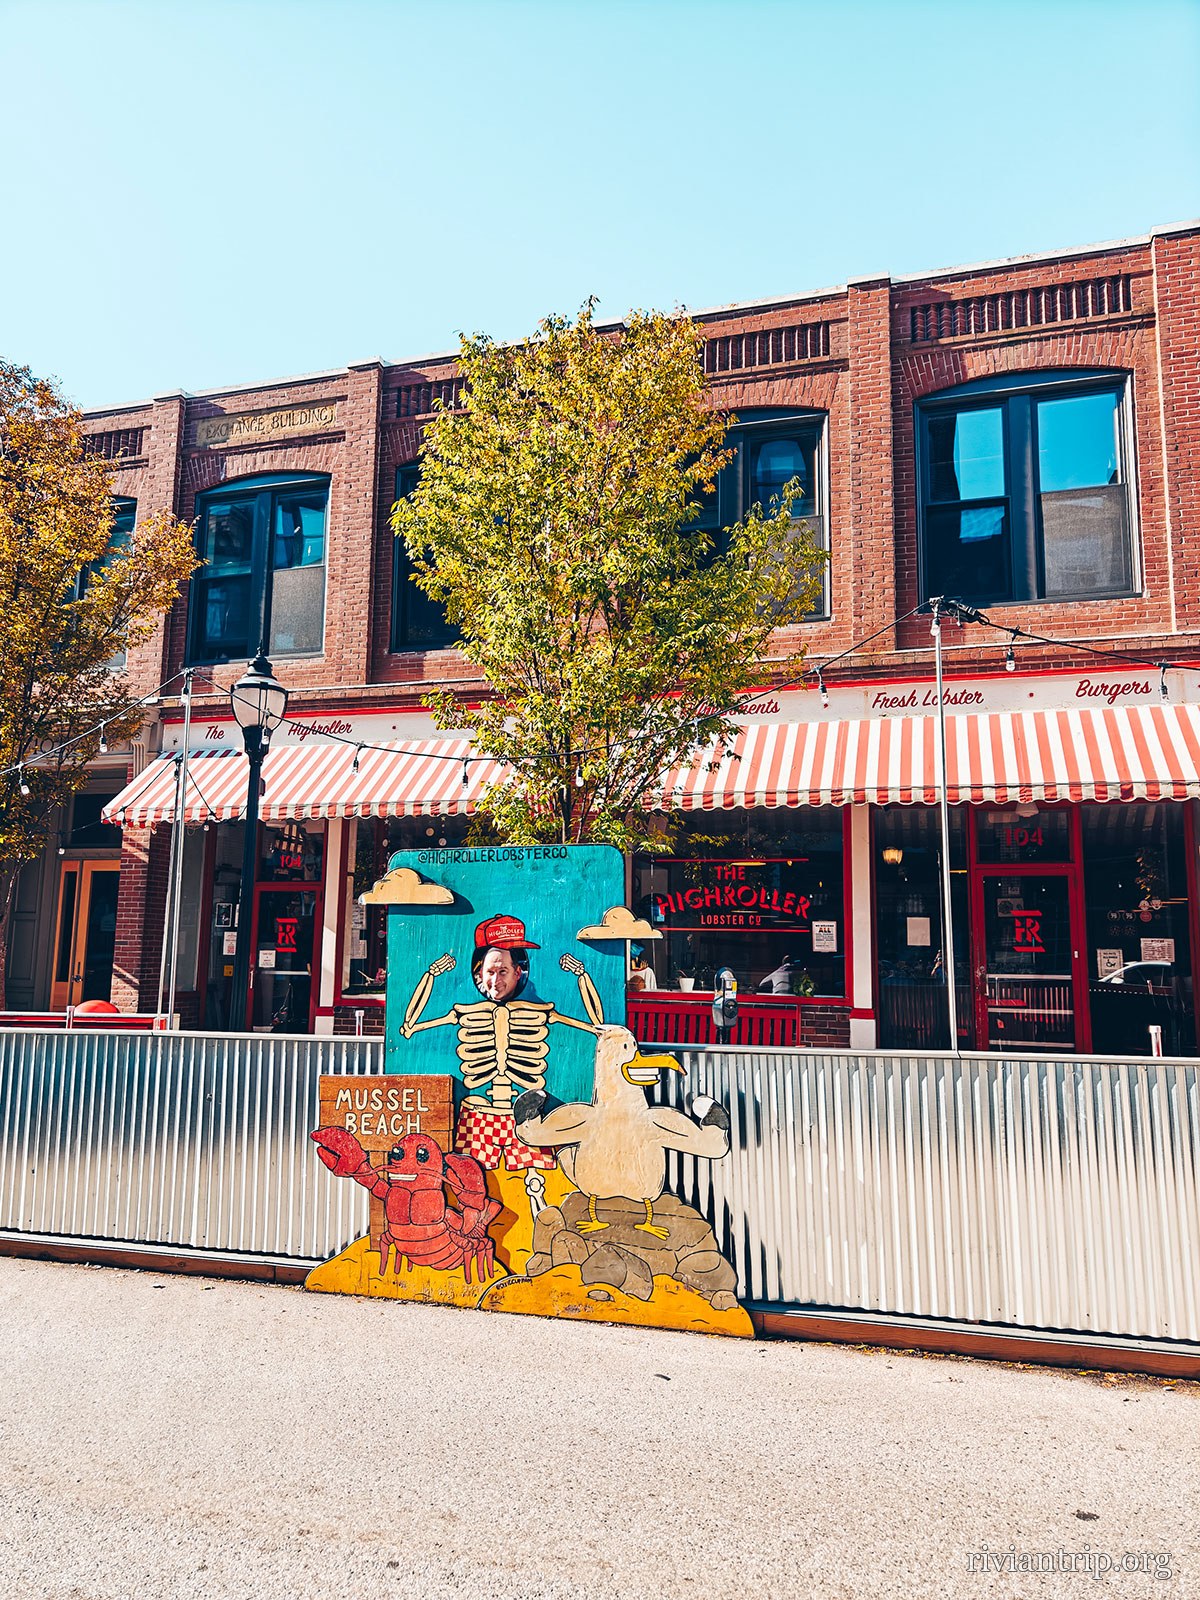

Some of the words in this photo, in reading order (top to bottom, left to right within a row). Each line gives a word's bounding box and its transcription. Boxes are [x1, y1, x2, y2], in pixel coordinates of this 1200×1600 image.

[206, 416, 265, 439] EXCHANGE
[271, 406, 334, 430] BUILDING
[872, 689, 918, 709] Fresh
[922, 688, 984, 706] Lobster
[1075, 679, 1152, 705] Burgers
[205, 726, 225, 740] The
[288, 720, 352, 741] Highroller
[1004, 827, 1044, 847] 104
[280, 855, 302, 868] 104
[418, 846, 568, 864] @HIGHROLLERLOBSTERCO
[714, 866, 746, 881] THE
[656, 885, 811, 919] HIGHROLLER
[701, 915, 745, 926] LOBSTER
[335, 1088, 430, 1112] MUSSEL
[345, 1112, 421, 1136] BEACH
